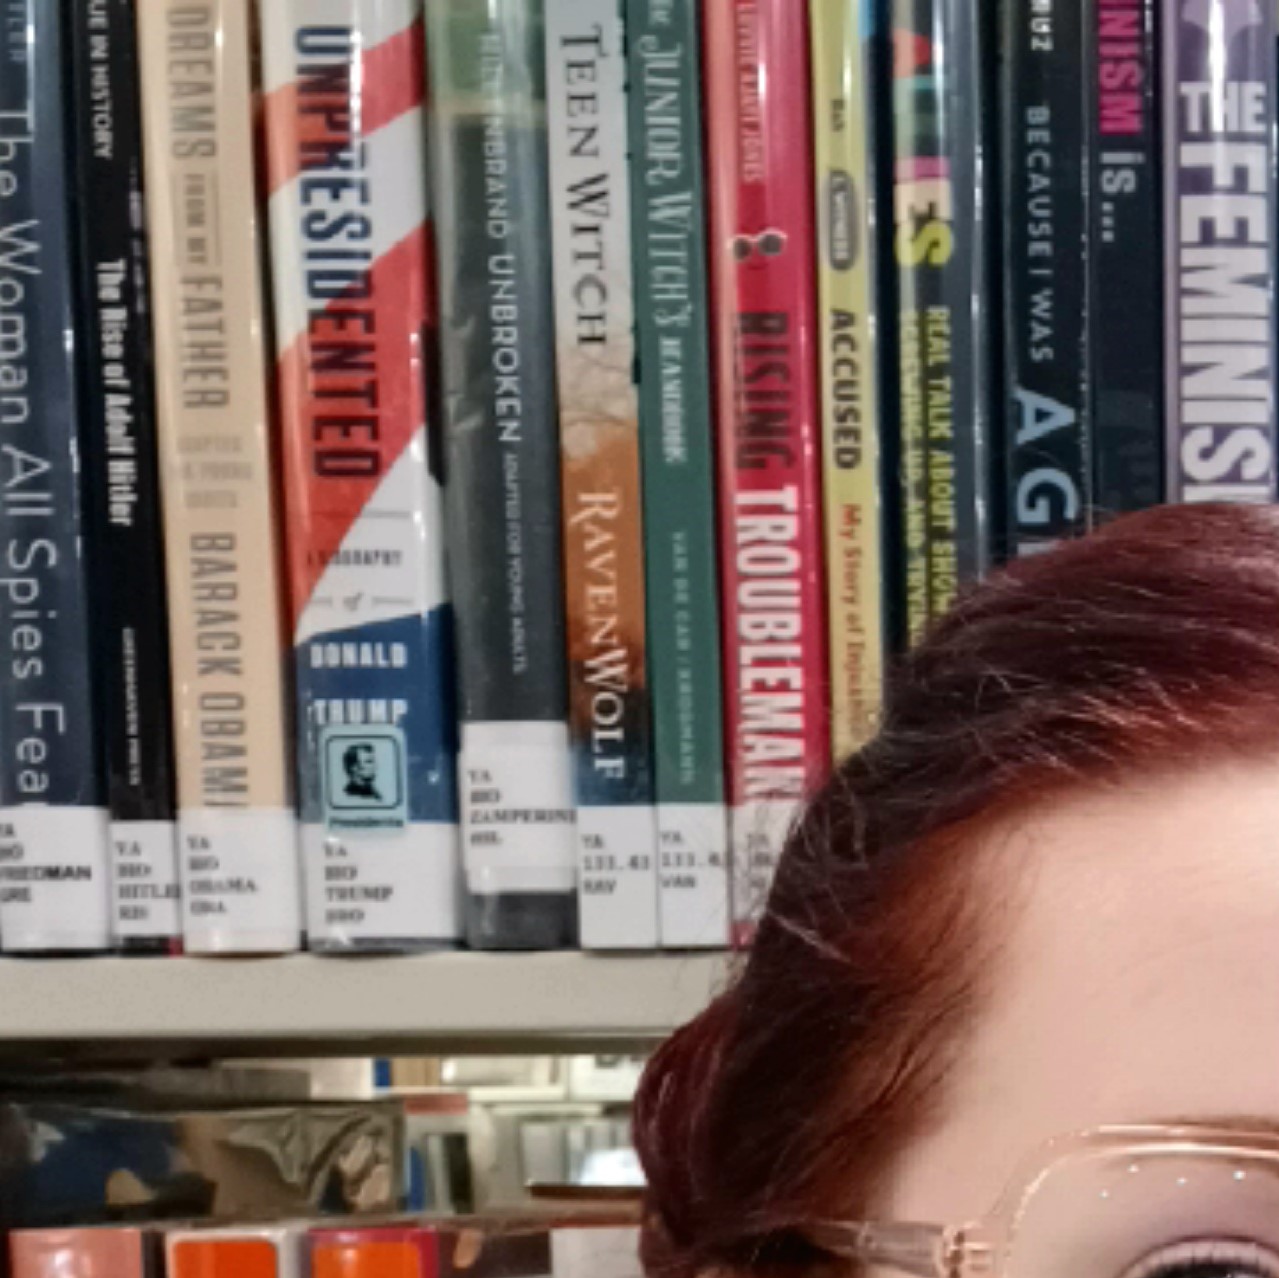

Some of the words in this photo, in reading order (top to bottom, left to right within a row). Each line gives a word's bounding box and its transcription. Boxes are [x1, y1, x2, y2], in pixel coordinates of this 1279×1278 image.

[91, 34, 111, 61] IN
[167, 7, 219, 159] DREAMS
[92, 64, 114, 159] HISTORY
[560, 22, 606, 159] TEEN
[639, 35, 684, 188] JUNIOR
[1179, 80, 1268, 132] THE
[0, 107, 35, 198] The
[1026, 106, 1054, 266] BECAUSE
[1101, 151, 1145, 243] is...
[97, 258, 127, 300] The
[295, 26, 383, 479] UNPRESIDENTED
[566, 171, 611, 347] WITCH
[649, 191, 693, 328] WITCH'S
[0, 219, 42, 424] Woman
[99, 306, 130, 358] Rise
[181, 275, 231, 409] FATHER
[486, 253, 522, 442] UNBROKEN
[927, 306, 953, 365] REAL
[1029, 288, 1053, 363] WAS
[1179, 142, 1271, 505] FEMINIS
[103, 363, 133, 386] of
[734, 311, 796, 470] RISING
[830, 309, 864, 470] ACCUSED
[927, 375, 953, 438] TALK
[1014, 384, 1078, 447] A
[104, 394, 136, 454] Adolf
[5, 444, 52, 516] All
[107, 458, 138, 526] Hitler
[503, 453, 518, 518] ADAPTED
[929, 450, 956, 530] ABOUT
[505, 521, 519, 555] FOR
[2, 538, 58, 680] Spies
[190, 532, 241, 676] BARACK
[507, 558, 522, 612] YOUNG
[310, 642, 407, 669] DONALD
[734, 485, 805, 803] TROUBLEMAK
[16, 703, 65, 794] Fea
[198, 691, 249, 808] OBAM
[581, 834, 605, 849] YA
[661, 832, 683, 847] YA
[325, 885, 394, 901] TRUMP
[660, 875, 697, 890] VAN
